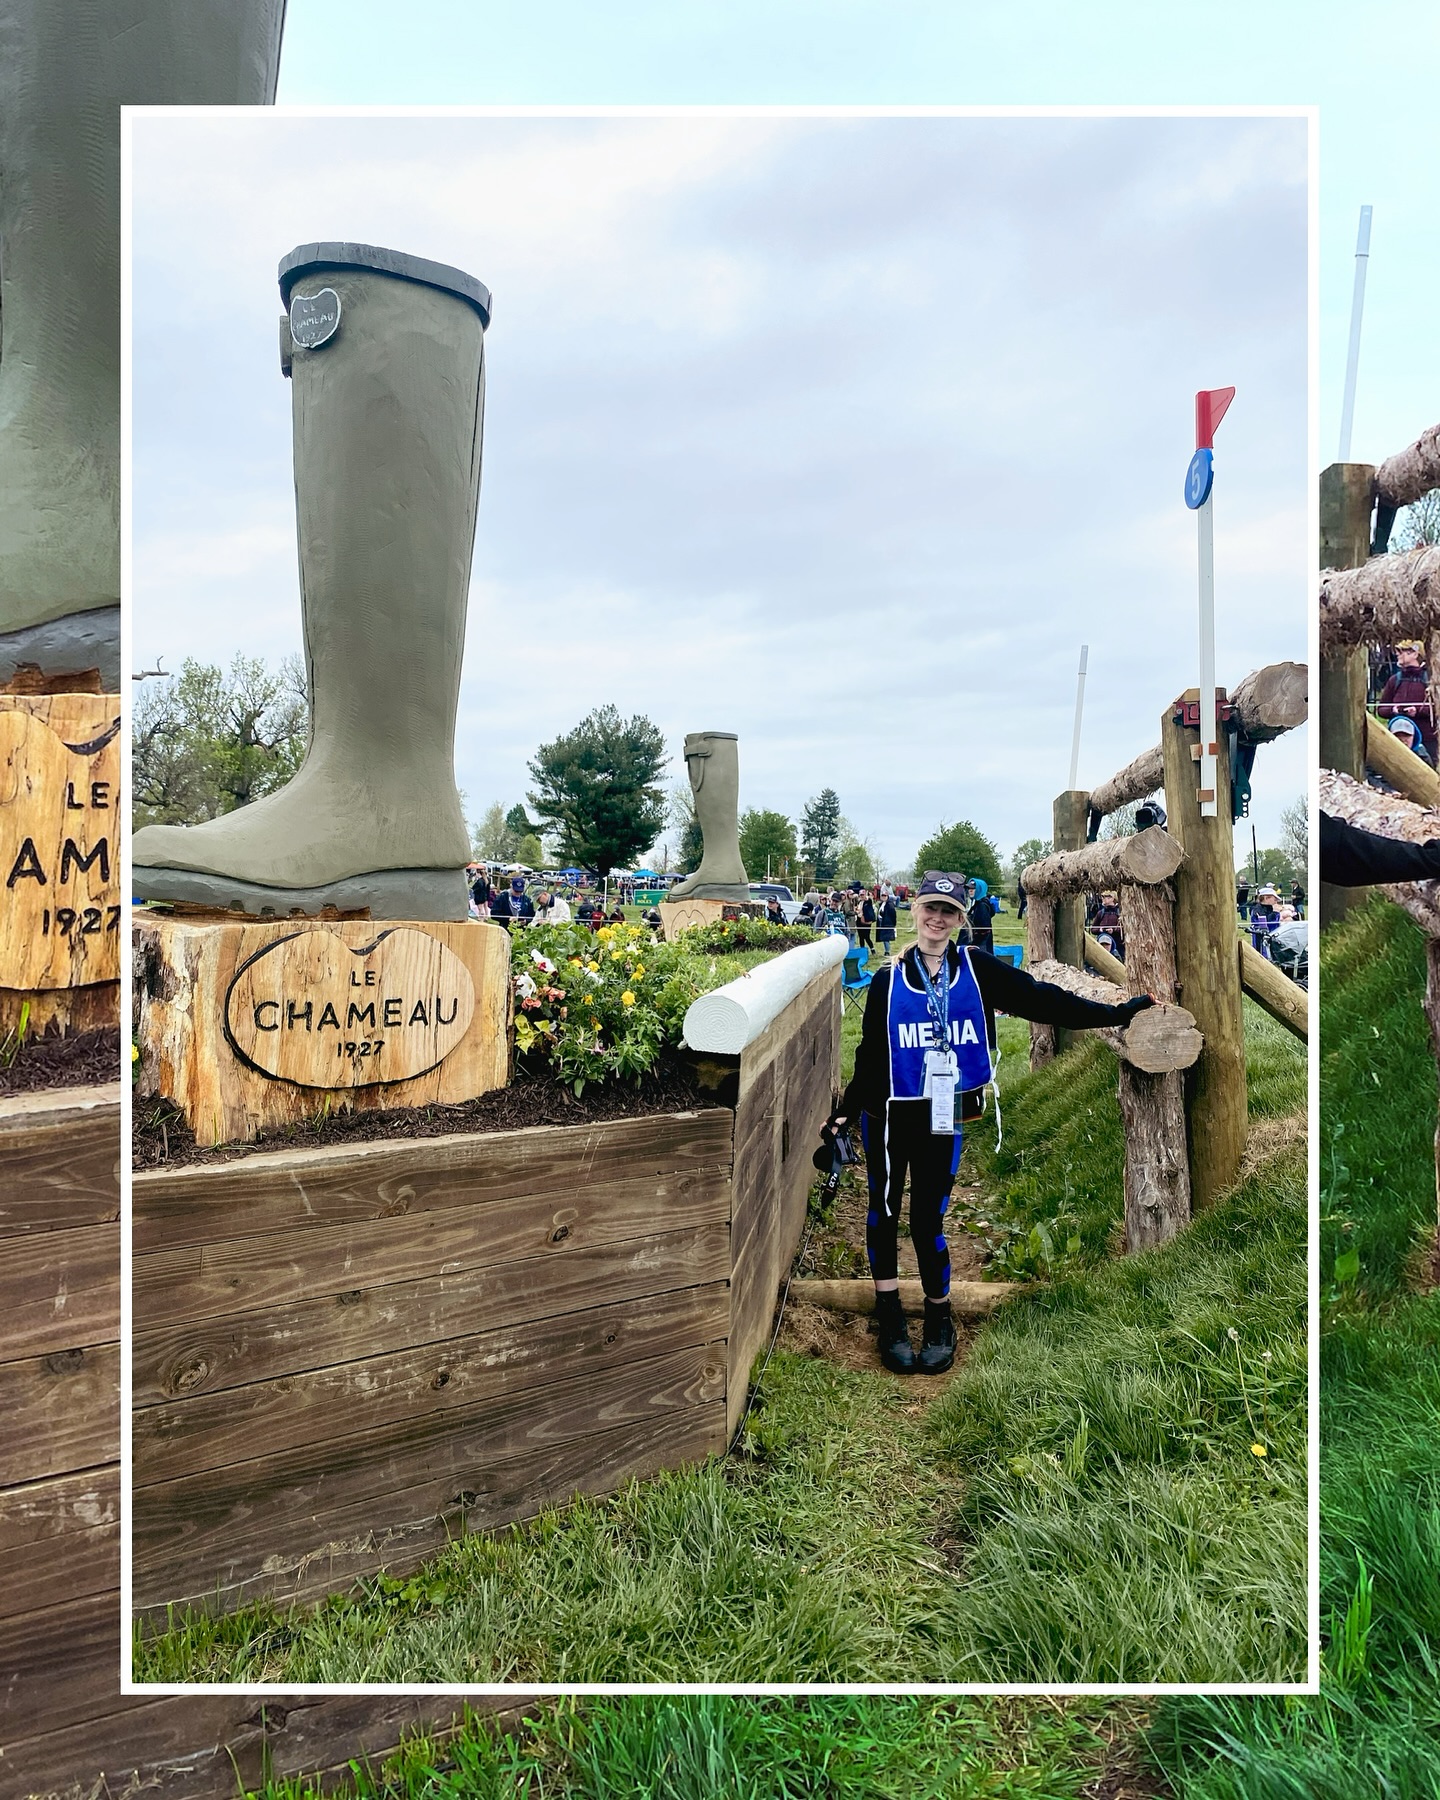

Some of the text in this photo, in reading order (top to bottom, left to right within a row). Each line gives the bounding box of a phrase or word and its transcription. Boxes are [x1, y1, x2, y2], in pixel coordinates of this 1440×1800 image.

[1192, 459, 1200, 500] 5
[67, 782, 110, 810] LE
[43, 905, 121, 936] 1927
[351, 971, 376, 987] LE
[253, 998, 458, 1032] CHAMEAU
[898, 1019, 979, 1048] MEIA
[337, 1040, 386, 1057] 1927
